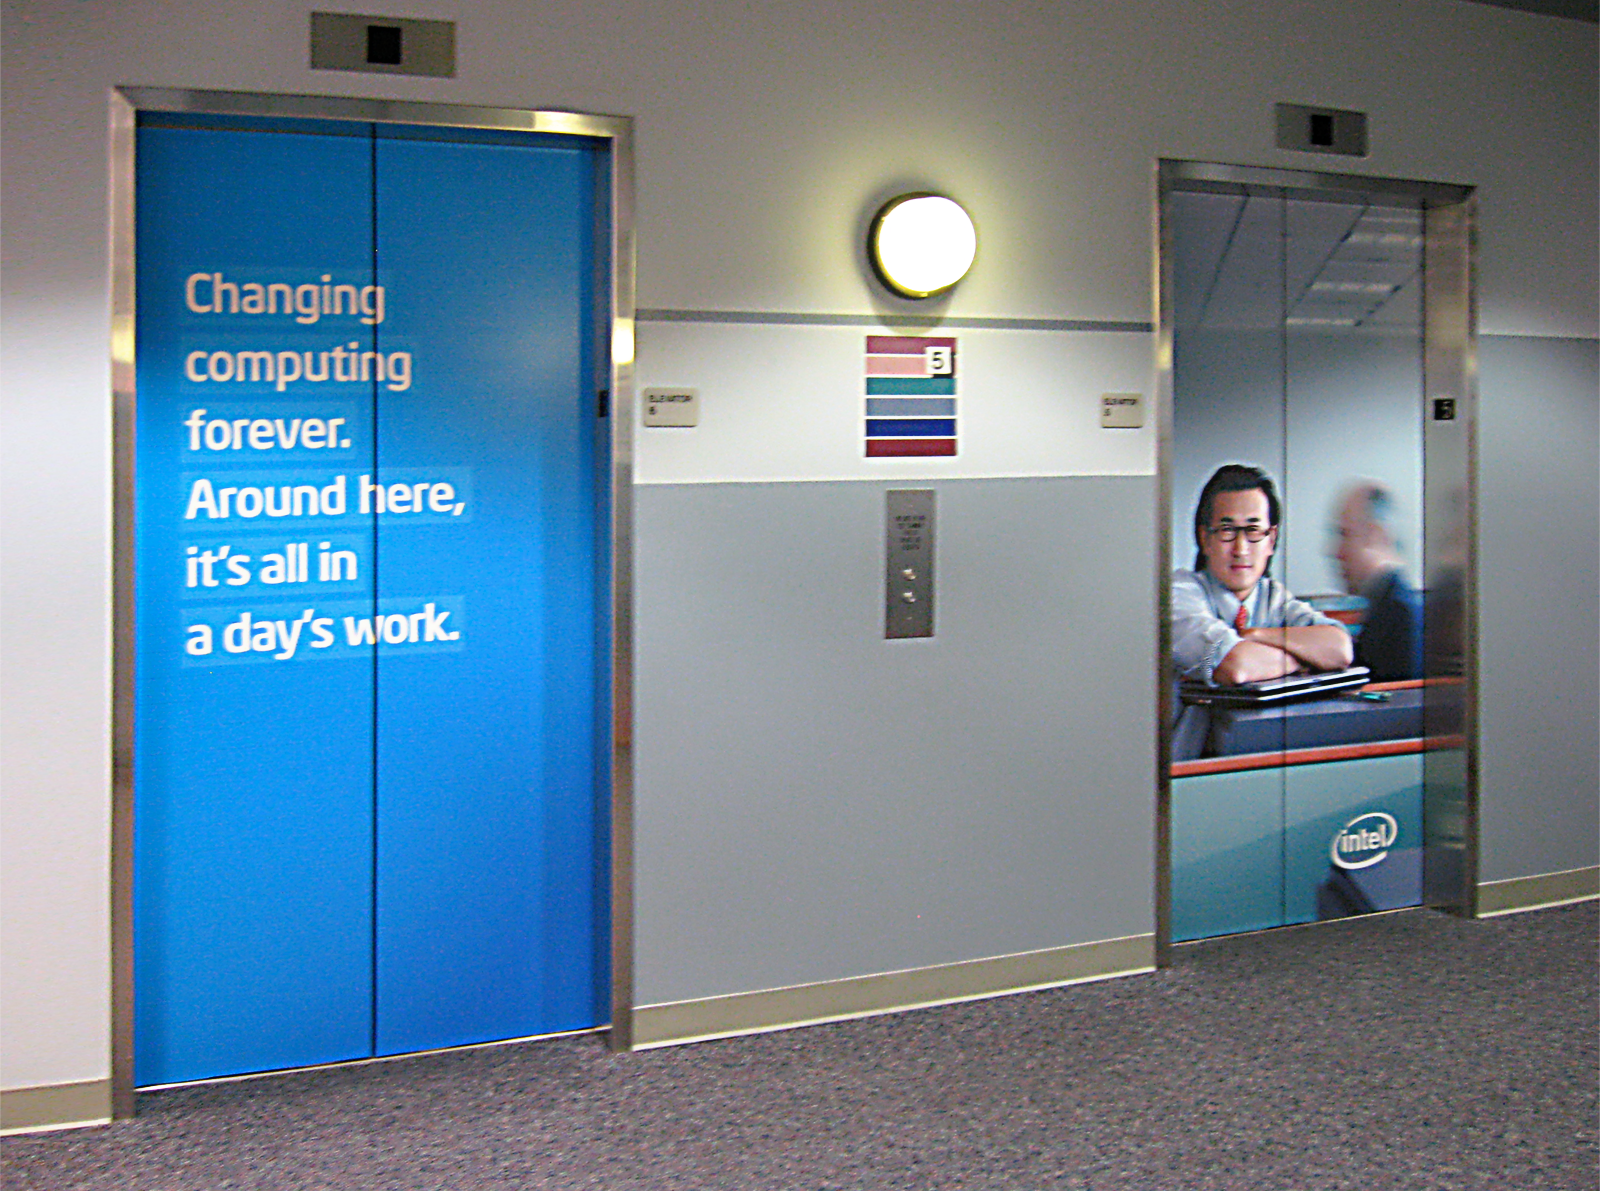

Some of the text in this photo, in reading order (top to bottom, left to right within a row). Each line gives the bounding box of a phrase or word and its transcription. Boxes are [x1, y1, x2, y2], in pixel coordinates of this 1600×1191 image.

[185, 273, 386, 325] Changing
[184, 342, 413, 392] computing
[932, 351, 945, 370] 5
[184, 409, 352, 451] forever.
[184, 475, 466, 519] Around here,
[185, 541, 358, 588] it's all in
[185, 603, 461, 661] a day's work.
[1341, 824, 1386, 853] intel
